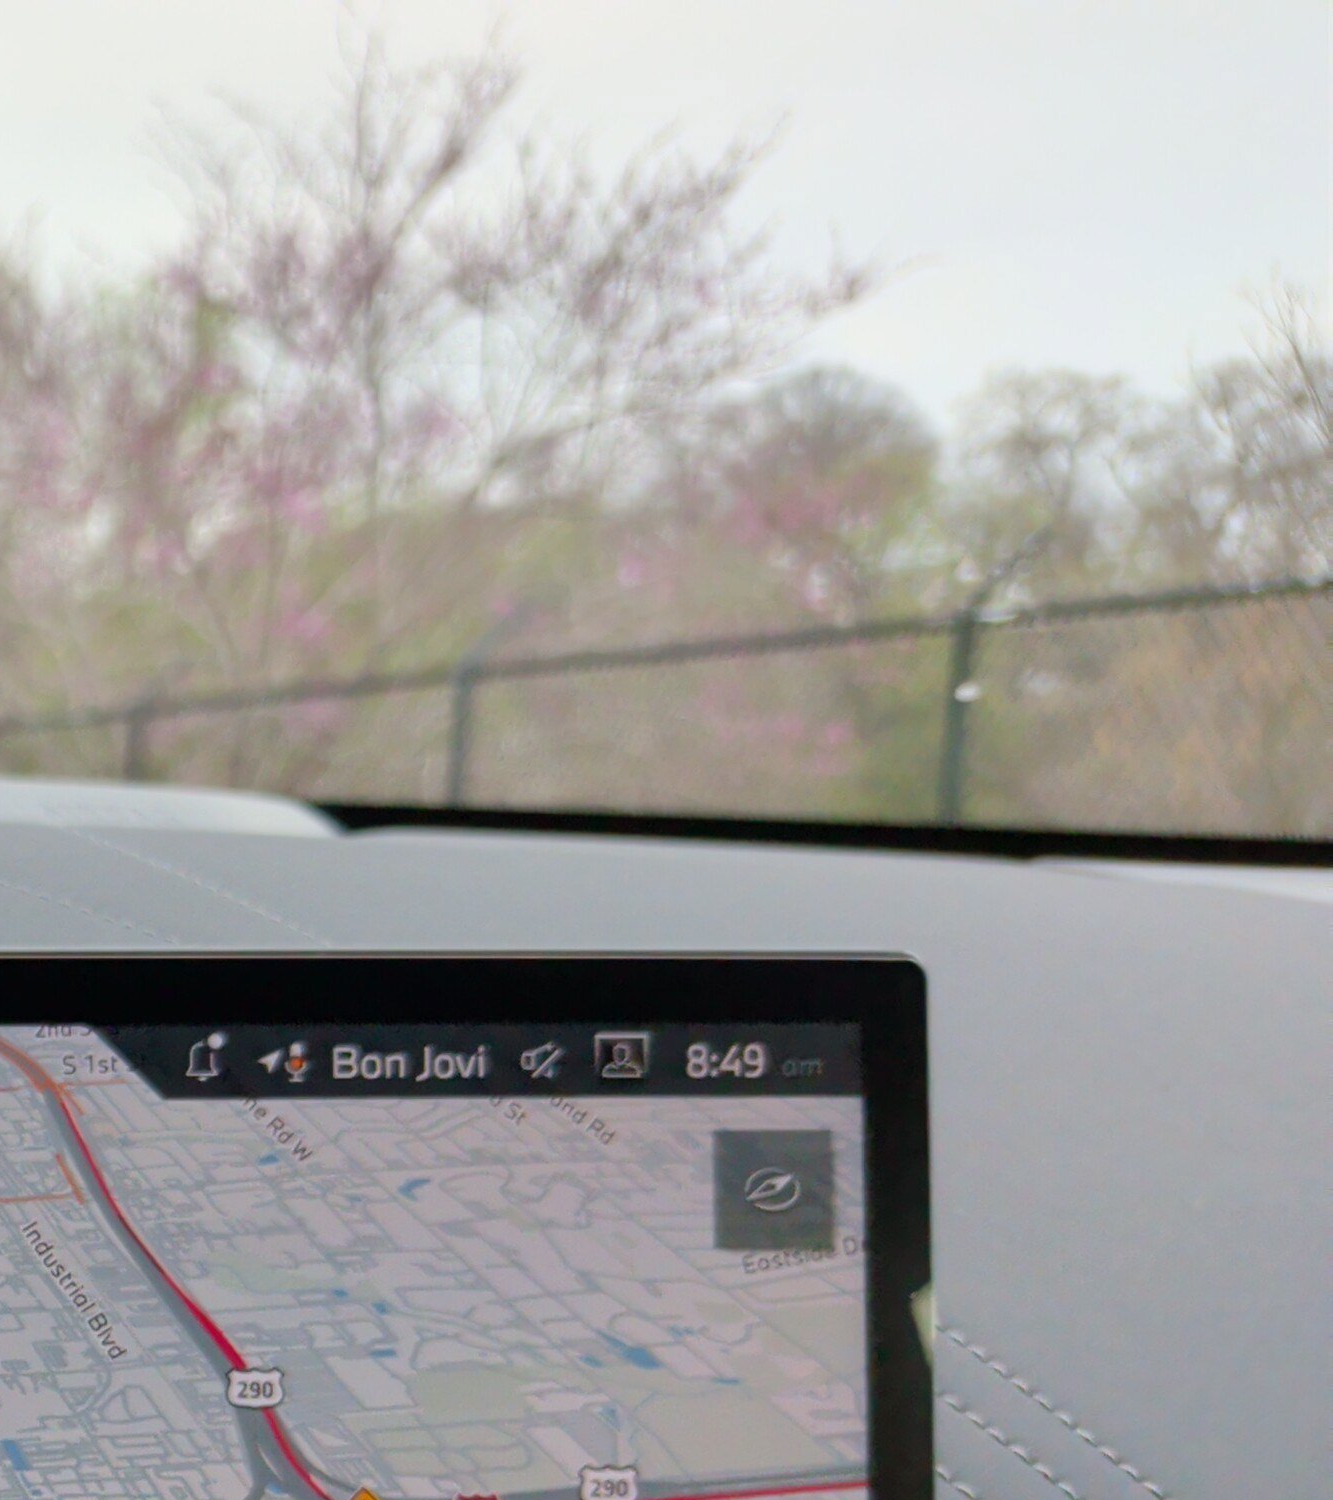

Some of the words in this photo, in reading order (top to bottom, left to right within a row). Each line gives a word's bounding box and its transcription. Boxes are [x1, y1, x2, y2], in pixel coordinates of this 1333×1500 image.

[62, 1055, 77, 1075] S
[84, 1055, 118, 1074] 1st
[332, 1044, 406, 1080] Bon
[415, 1043, 488, 1081] Jovi
[685, 1042, 767, 1079] 8:49
[23, 1221, 95, 1308] Industrial
[88, 1306, 127, 1360] Blvd
[237, 1380, 274, 1400] 290
[590, 1478, 629, 1498] 290
